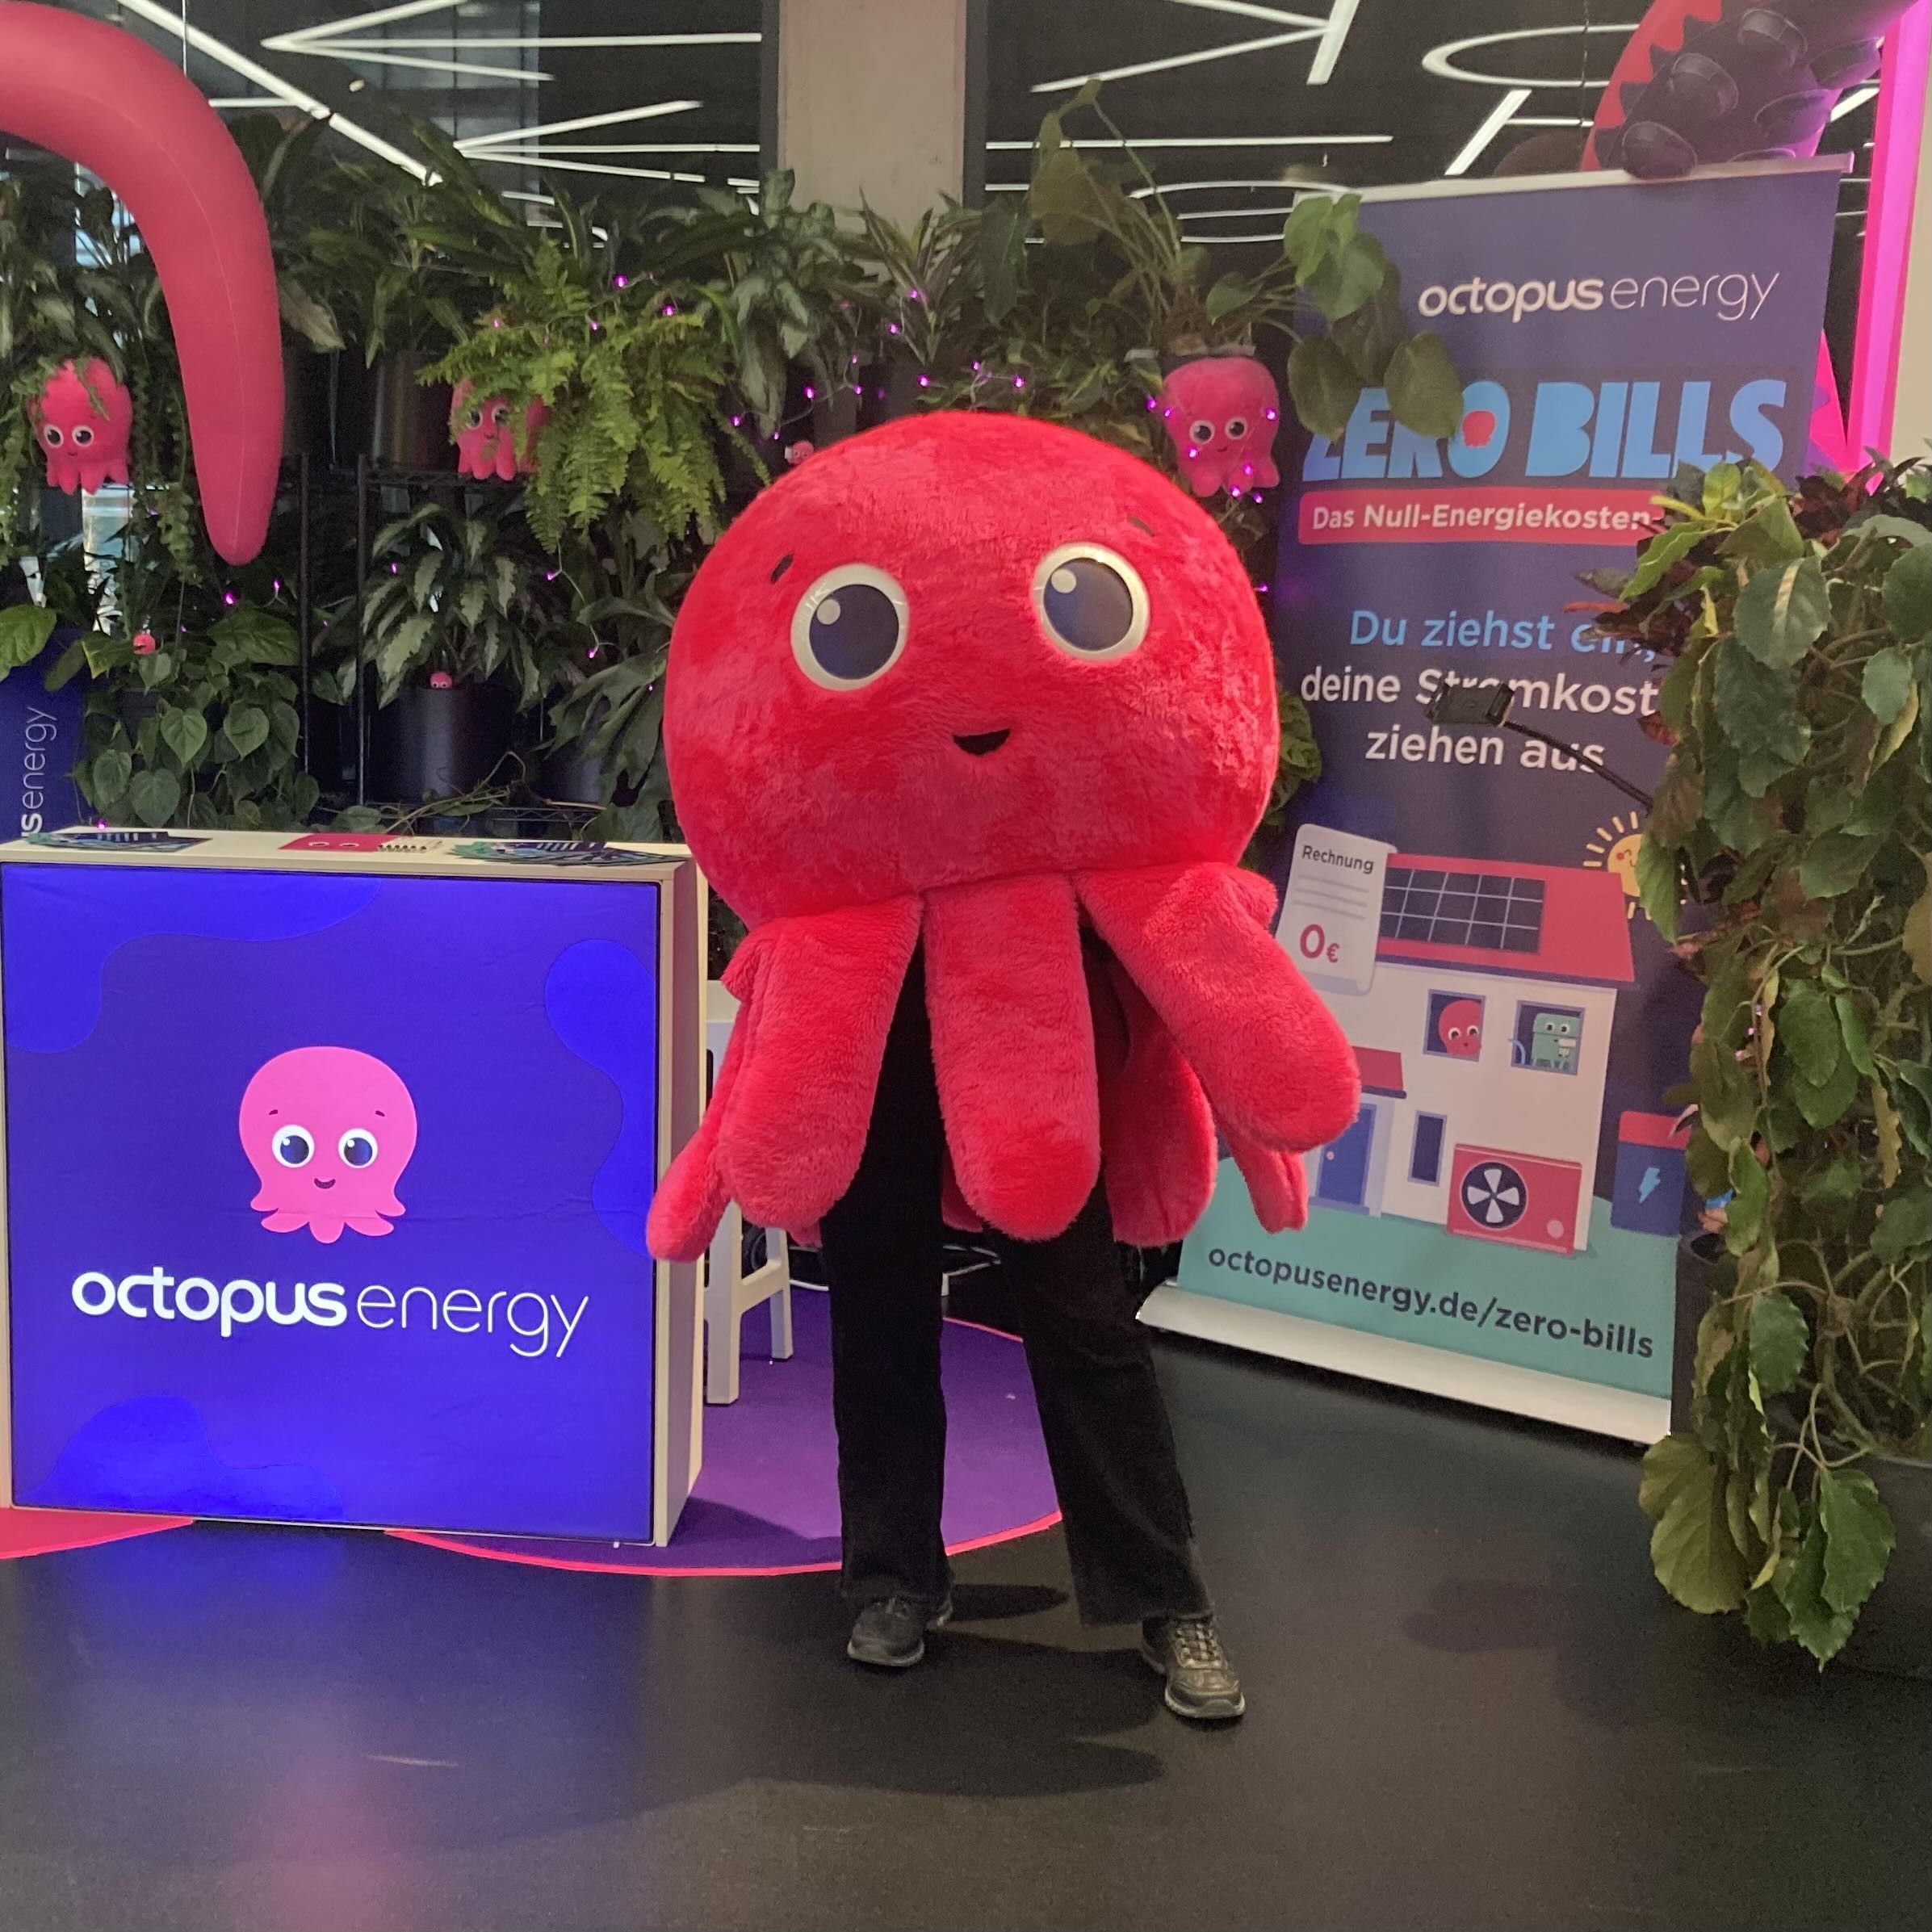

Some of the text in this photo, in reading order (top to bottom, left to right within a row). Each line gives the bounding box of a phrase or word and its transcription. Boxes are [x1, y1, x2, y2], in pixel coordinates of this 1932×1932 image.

[1419, 272, 1779, 323] octopus energy
[1525, 379, 1787, 479] BILLS
[1313, 506, 1356, 530] Das
[1350, 610, 1408, 646] Du
[1421, 610, 1556, 650] ziehst
[1301, 665, 1401, 702] deine
[22, 706, 57, 810] energy
[1365, 723, 1605, 773] ziehen aus
[1301, 844, 1374, 874] Rechnung
[71, 1266, 589, 1358] octopus energy
[1208, 1245, 1653, 1359] octopusenergy.de/zero-bills
